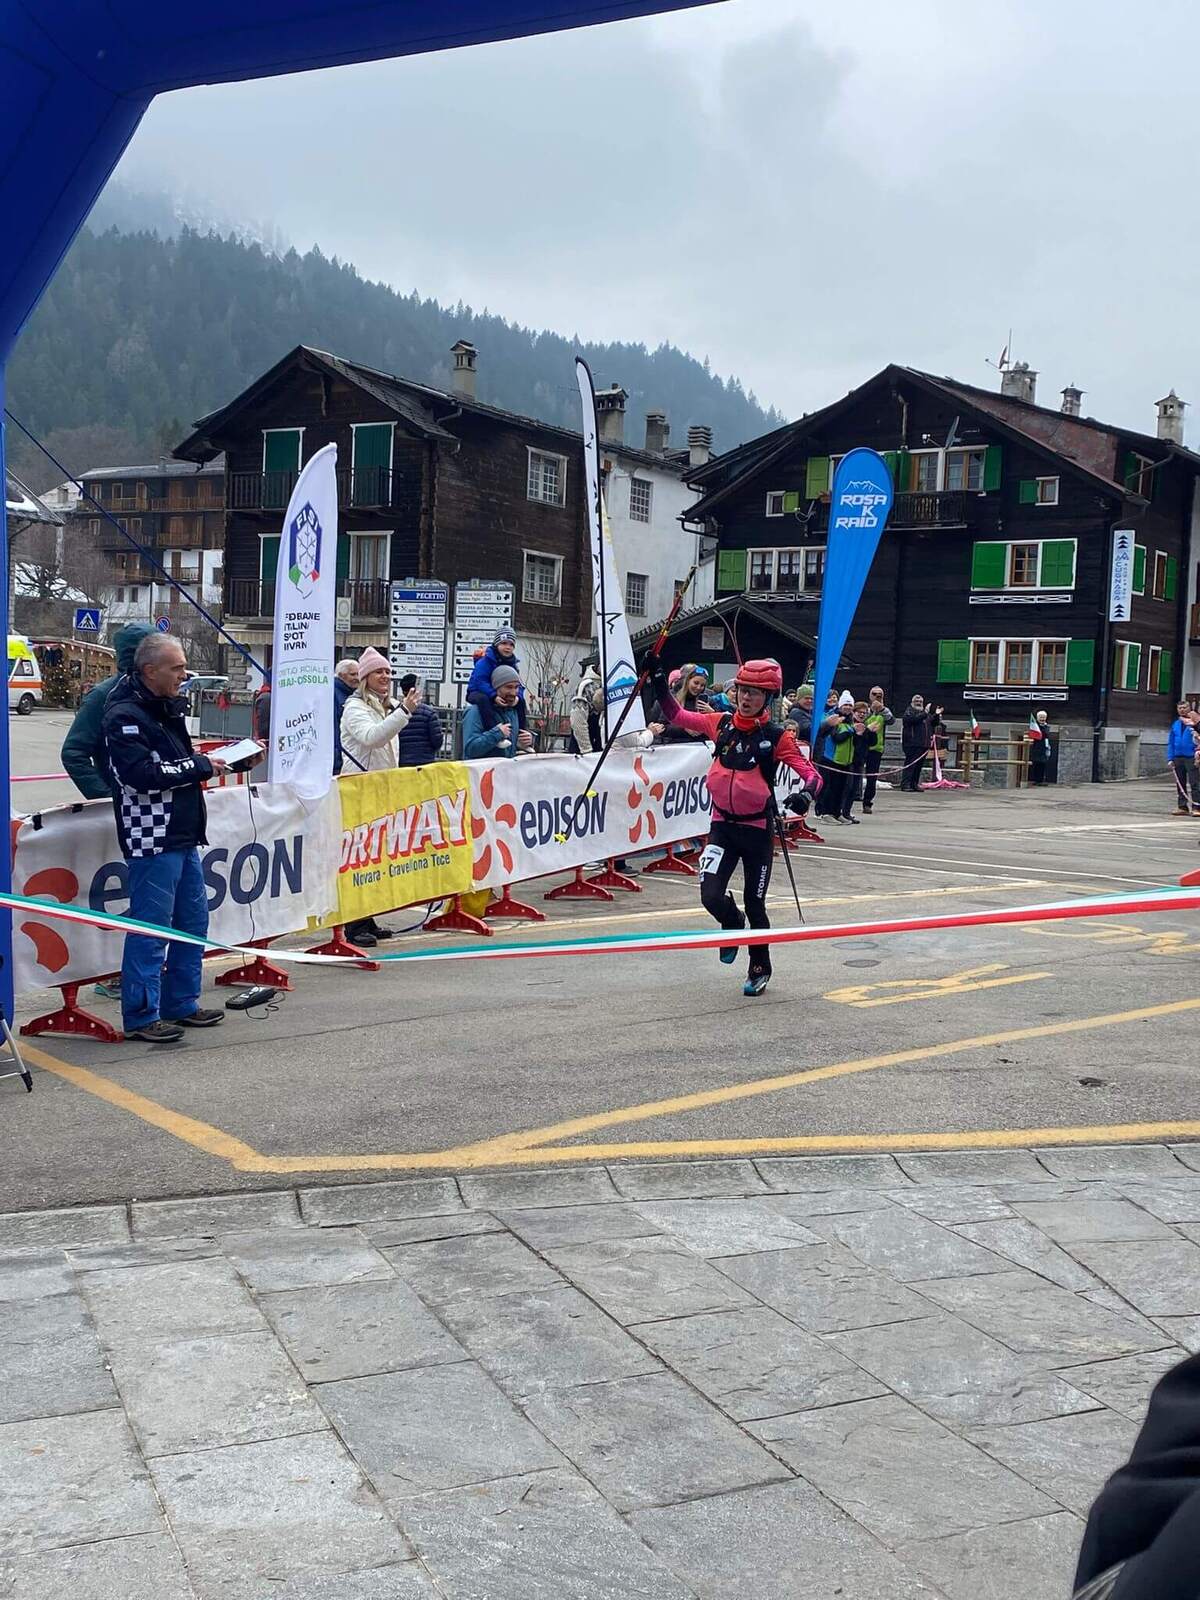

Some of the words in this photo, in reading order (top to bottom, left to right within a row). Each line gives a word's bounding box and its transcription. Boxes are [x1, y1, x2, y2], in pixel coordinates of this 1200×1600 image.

[840, 494, 888, 508] ROSA
[296, 510, 319, 531] FISI
[835, 517, 878, 530] RAID
[415, 592, 445, 600] PECETTO
[757, 864, 768, 899] ATOMIC
